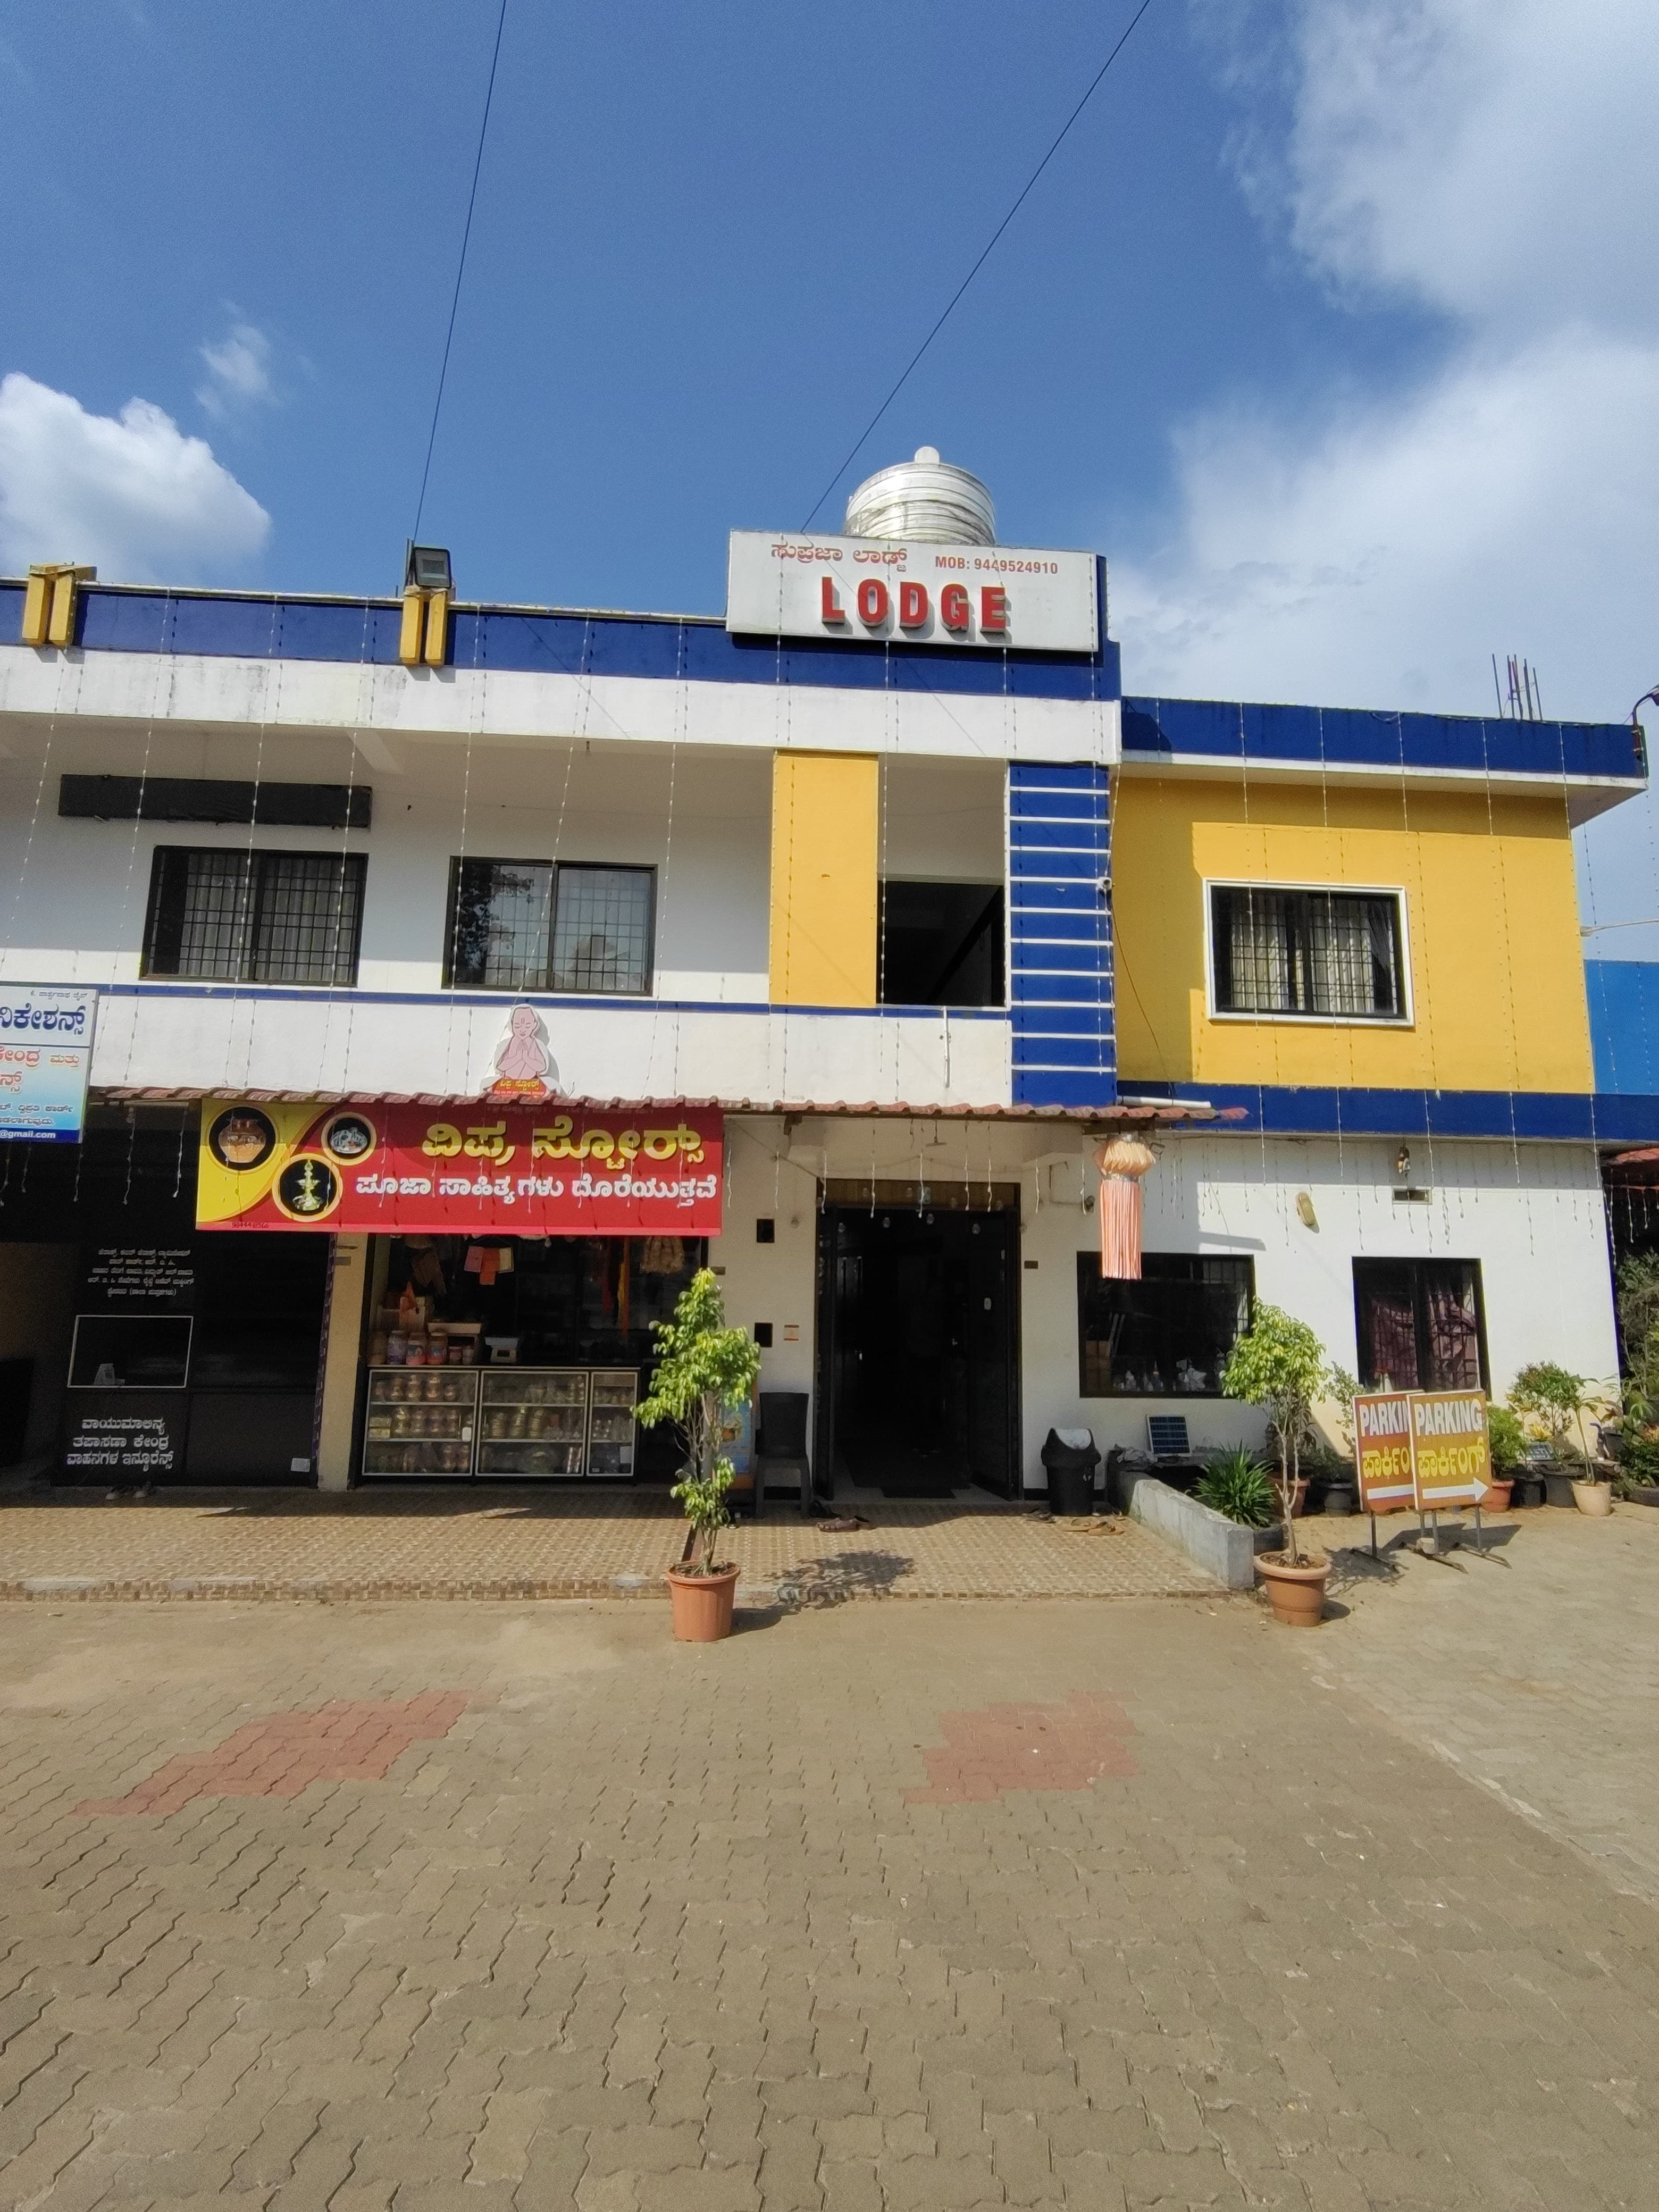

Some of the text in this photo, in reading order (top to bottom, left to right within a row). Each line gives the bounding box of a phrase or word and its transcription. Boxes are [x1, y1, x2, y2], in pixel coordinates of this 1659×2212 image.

[771, 541, 908, 572] ಸುಪ್ರಜಾ ಲಾಡ್ಜ್
[935, 556, 1058, 574] MOB: 9449524910
[822, 576, 1007, 633] LODGE
[50, 1053, 79, 1067] ಮತ್ತು
[422, 1115, 705, 1169] ವಿಪ್ರ ಸ್ಟೋರ್ಸ್
[356, 1174, 431, 1195] ಪೂಜಾ
[572, 1173, 717, 1206] ದೊರೆಯುತ್ತವೆ
[82, 1416, 166, 1435] ವಾಯುಮಾಲಿನ್ಯ
[1359, 1400, 1409, 1437] PARKIN
[1414, 1398, 1482, 1436] PARKING
[66, 1450, 119, 1464] ವಾಹನಗಳ
[73, 1434, 169, 1450] ತಪಾಸಣಾ ಕೇಂದ್ರ
[1417, 1436, 1485, 1479] ಪಾರ್ಕಿಂಗ್
[1362, 1446, 1412, 1479] ಪಾರ್ಕಿಂ
